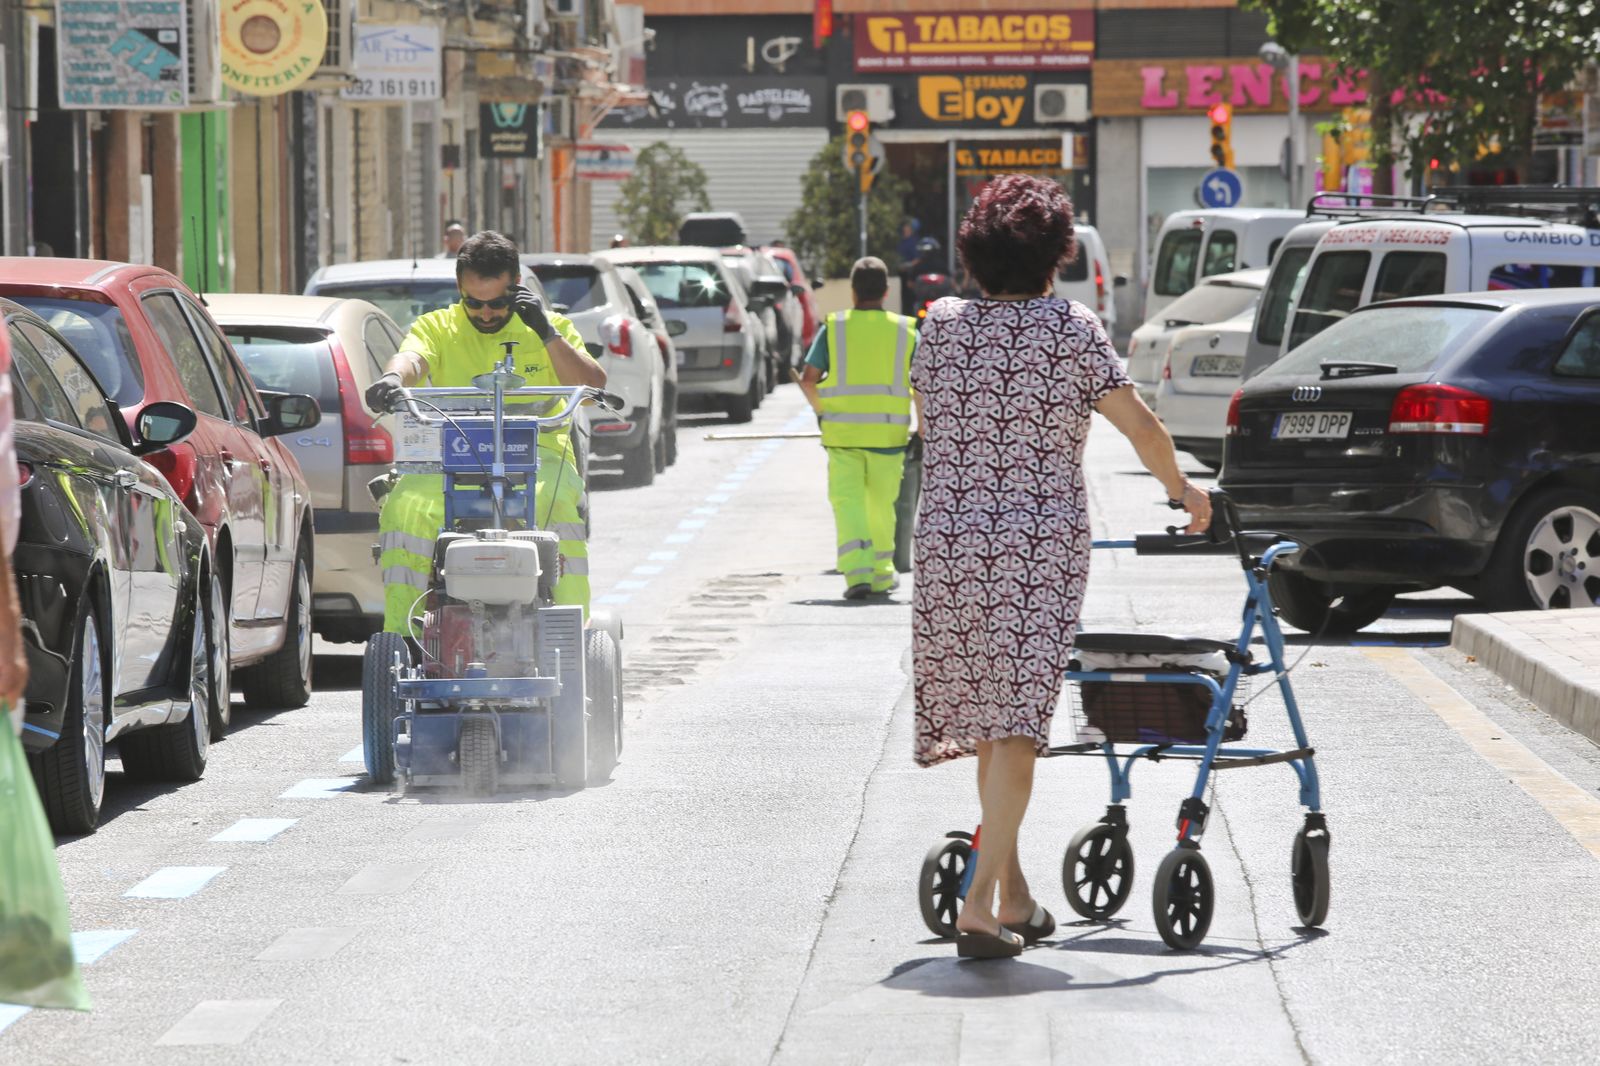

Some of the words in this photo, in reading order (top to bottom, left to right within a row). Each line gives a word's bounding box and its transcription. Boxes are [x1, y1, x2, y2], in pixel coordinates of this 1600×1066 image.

[914, 15, 1071, 41] TABACOS
[221, 56, 311, 88] ONFITERIA
[380, 79, 404, 96] 161
[408, 79, 436, 96] 911
[964, 75, 1027, 90] ESTANCO
[1503, 230, 1583, 246] CAMBIO
[1281, 415, 1316, 434] 7999
[1318, 414, 1348, 434] DPP
[296, 436, 331, 447] C4
